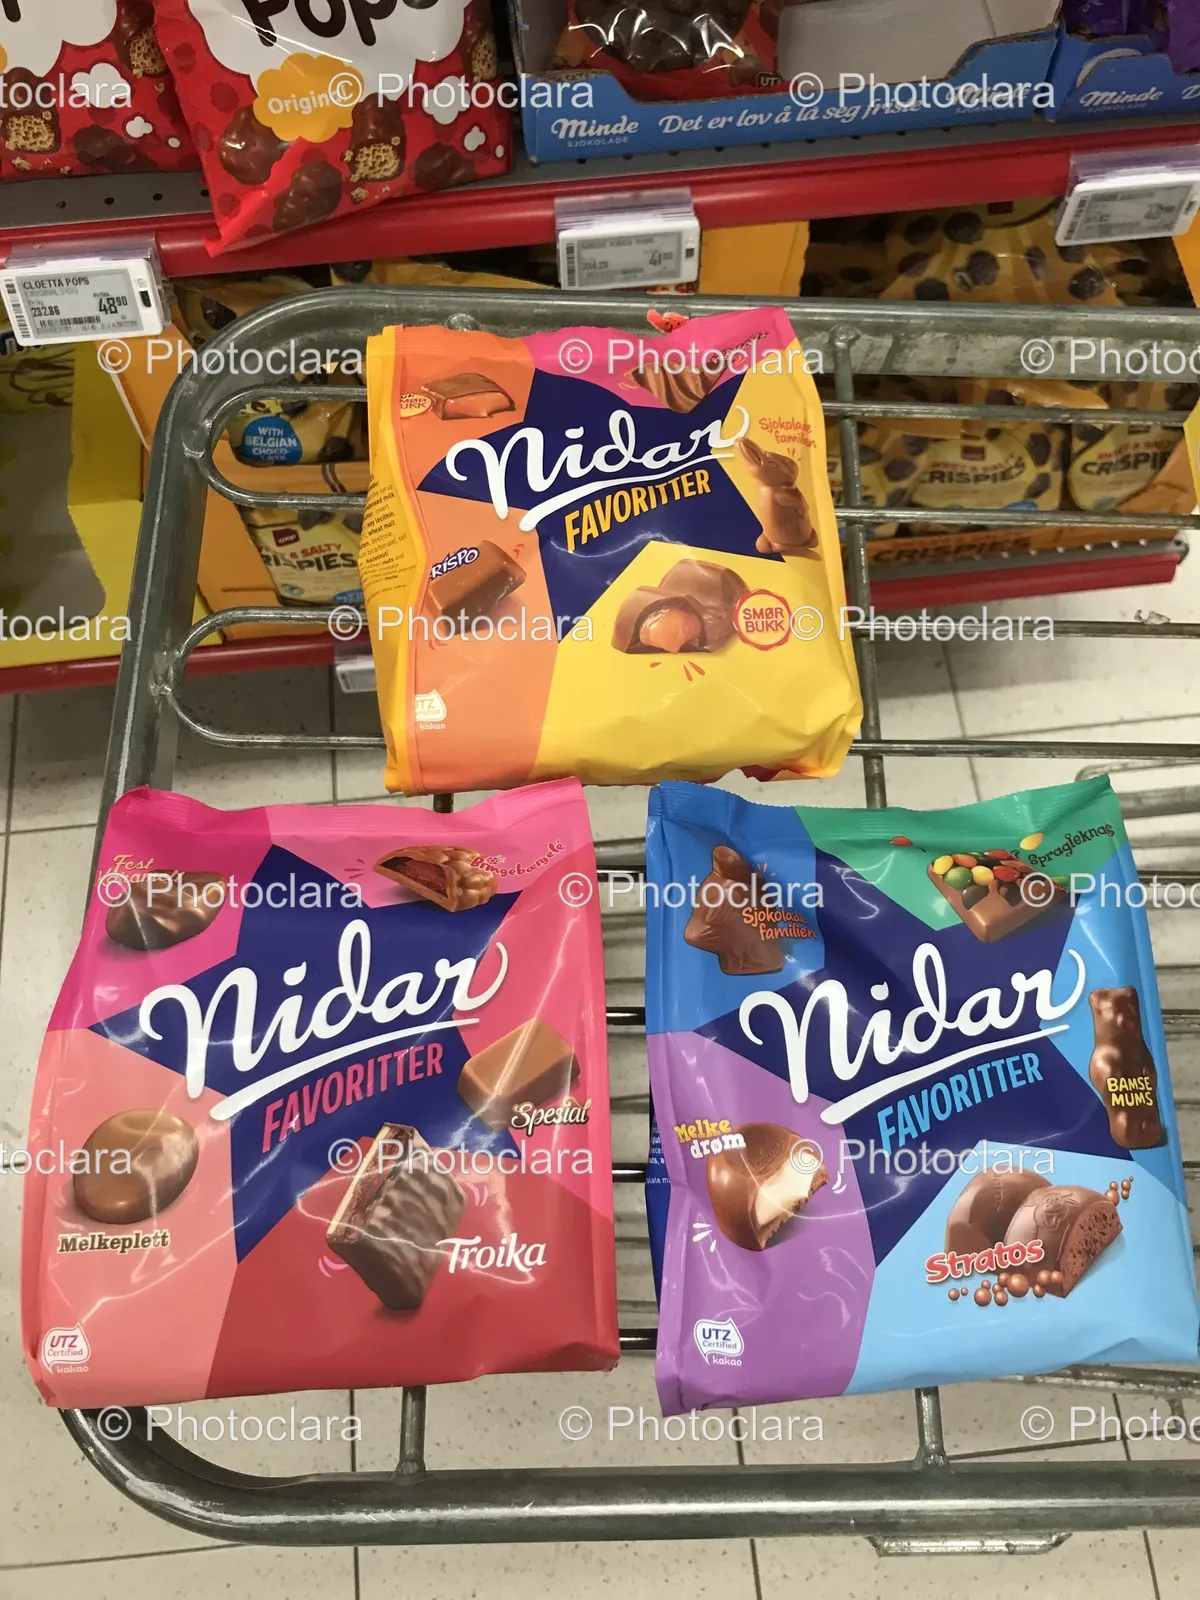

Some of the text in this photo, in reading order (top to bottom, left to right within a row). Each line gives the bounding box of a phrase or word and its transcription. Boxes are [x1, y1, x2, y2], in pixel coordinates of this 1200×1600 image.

[551, 115, 639, 139] Minde
[658, 115, 703, 133] Det
[707, 116, 734, 130] er
[736, 109, 773, 127] lov
[774, 105, 792, 123] å
[822, 105, 861, 123] seg
[23, 277, 89, 290] CLOETTA POPS
[258, 426, 284, 437] WITH
[245, 435, 297, 448] BELGIAN
[564, 469, 712, 554] FAVORITTER
[301, 543, 342, 558] SALTY
[430, 547, 480, 580] RISPO
[742, 606, 784, 620] SMØR
[745, 618, 785, 633] BUKK
[113, 854, 154, 874] Fest
[758, 922, 818, 942] familien
[1106, 1076, 1153, 1093] BAMSE
[261, 1042, 444, 1153] FAVORITTER
[876, 1052, 1044, 1158] FAVORITTER
[1110, 1092, 1154, 1108] MUMS
[510, 1095, 593, 1136] Spesial
[673, 1117, 732, 1145] Melke
[689, 1130, 747, 1159] drøm
[57, 1229, 171, 1254] Melkeplett
[436, 1232, 548, 1274] Troika
[924, 1238, 1045, 1284] Stratos
[49, 1334, 79, 1349] UTZ
[701, 1327, 732, 1341] UTZ
[47, 1347, 84, 1357] Certified
[701, 1339, 738, 1350] Certified
[712, 1354, 742, 1366] kakao
[56, 1365, 89, 1374] kakao
